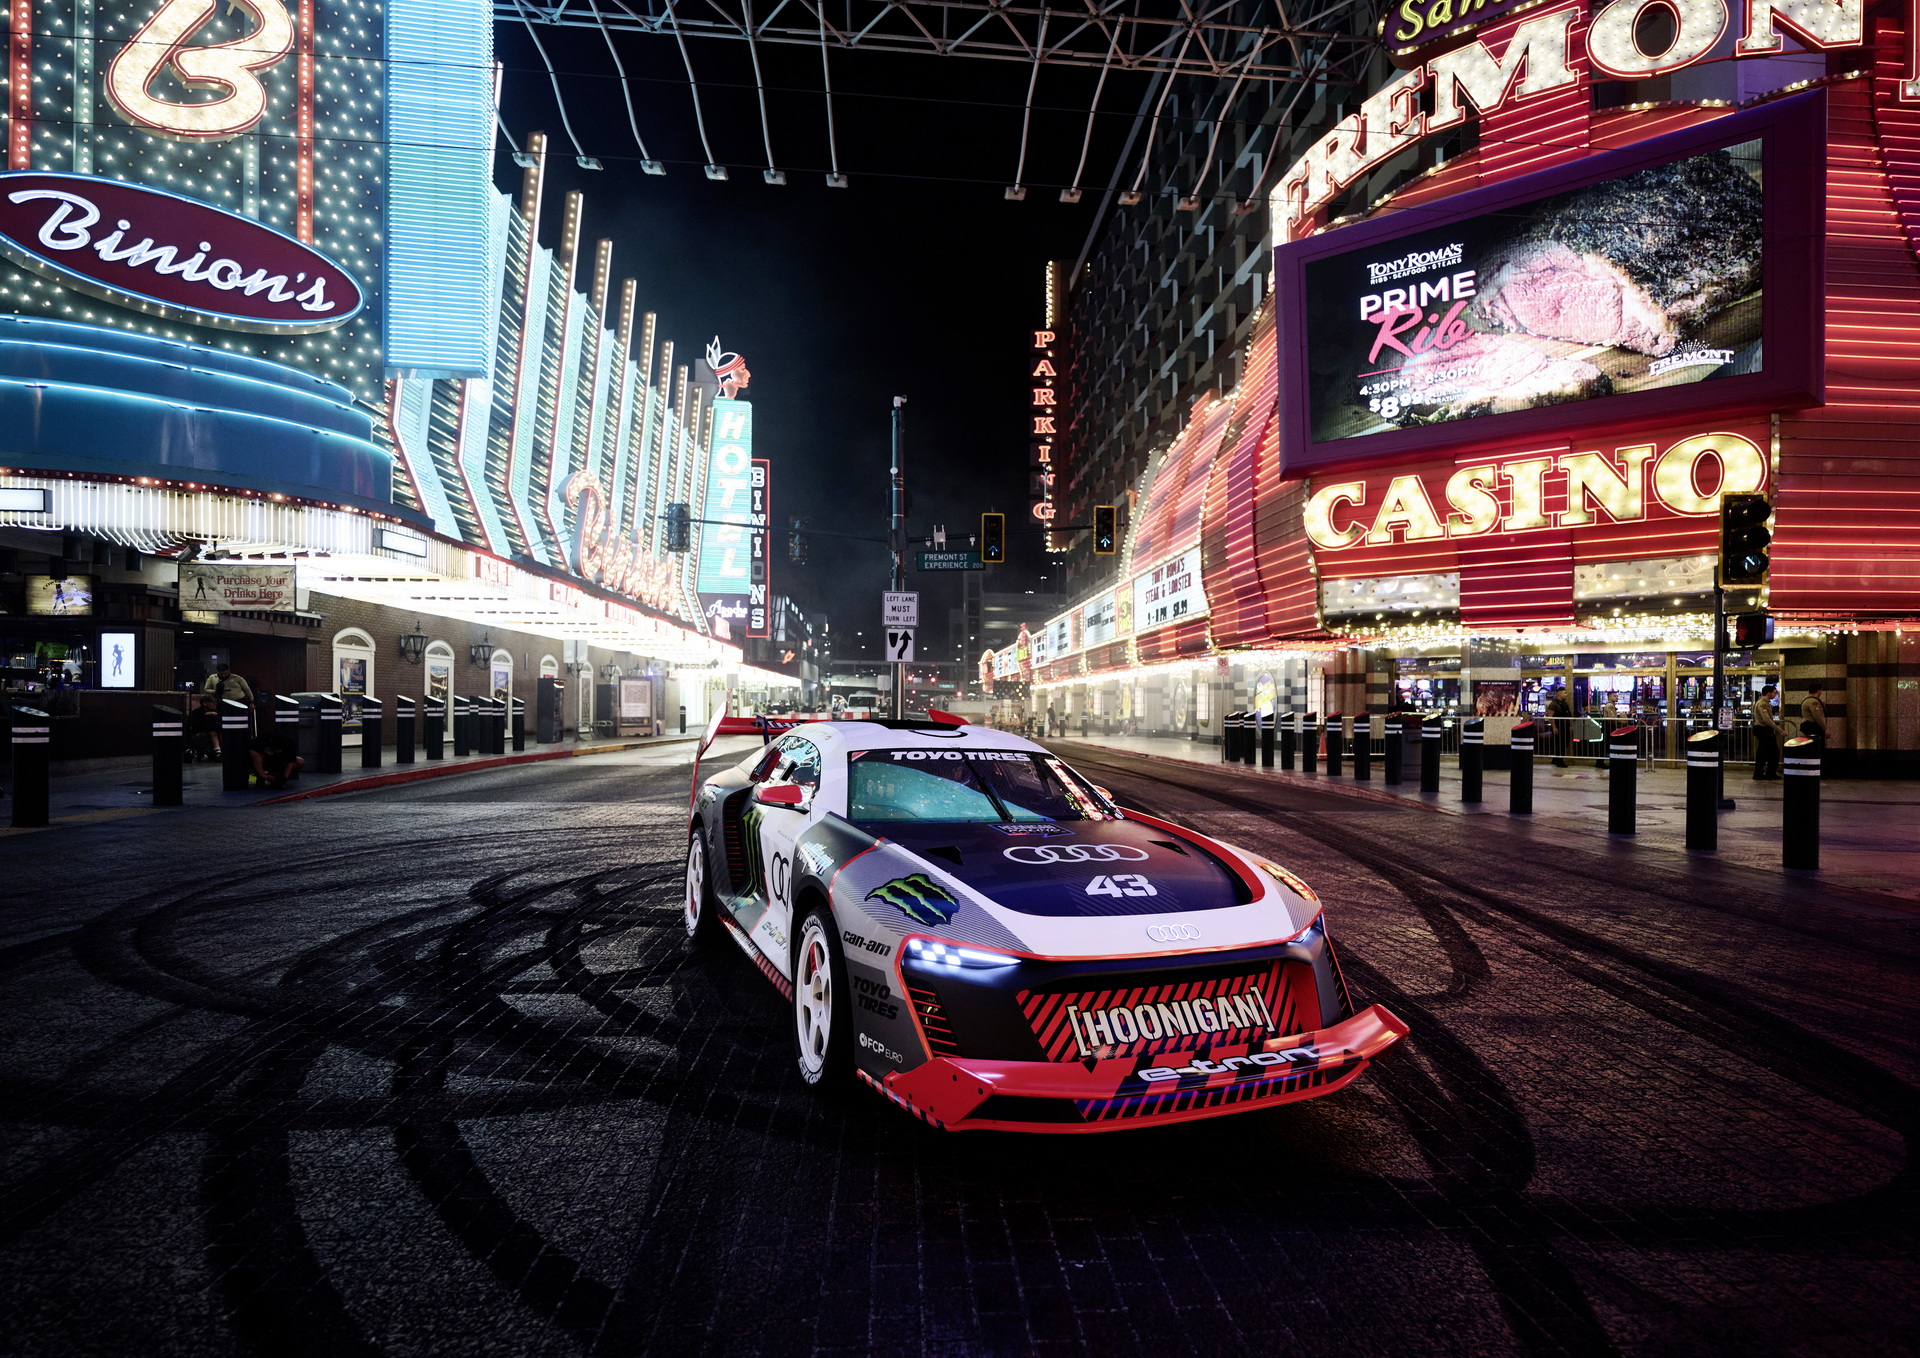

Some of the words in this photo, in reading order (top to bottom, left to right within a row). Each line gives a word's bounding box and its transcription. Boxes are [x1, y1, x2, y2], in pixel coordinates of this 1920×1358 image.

[105, 0, 294, 140] B
[1271, 0, 1920, 245] FREMON
[8, 189, 336, 312] Binion's
[1370, 277, 1388, 285] RIBS
[1392, 266, 1427, 279] SEAFOOD
[1432, 257, 1462, 270] STEAKS
[1360, 269, 1477, 321] PRIME
[1368, 300, 1475, 364] Rib
[1648, 349, 1735, 376] FREMONT
[1359, 377, 1411, 396] 4:30PM
[1032, 330, 1057, 520] PARKING
[716, 411, 747, 577] HOTEL
[1304, 432, 1767, 551] CASINO
[750, 466, 766, 629] BINIONS
[924, 553, 958, 561] FREMONT
[959, 553, 968, 561] ST
[924, 561, 968, 569] EXPERIENCE
[217, 573, 261, 585] Purchase
[265, 575, 288, 587] Your
[224, 587, 257, 599] Drinks
[259, 588, 284, 599] Here
[891, 605, 911, 613] MUST
[1145, 586, 1160, 605] STEAK
[890, 750, 964, 761] TOYO
[965, 751, 1031, 762] TIRES
[1084, 874, 1158, 898] 43
[843, 930, 892, 957] can-am
[853, 975, 891, 1000] TOYO
[857, 993, 900, 1021] TIRES
[1066, 986, 1276, 1057] [HOONIGAN]
[867, 1037, 885, 1054] FCP
[885, 1048, 903, 1064] EURO
[1138, 1047, 1322, 1082] e-tron
